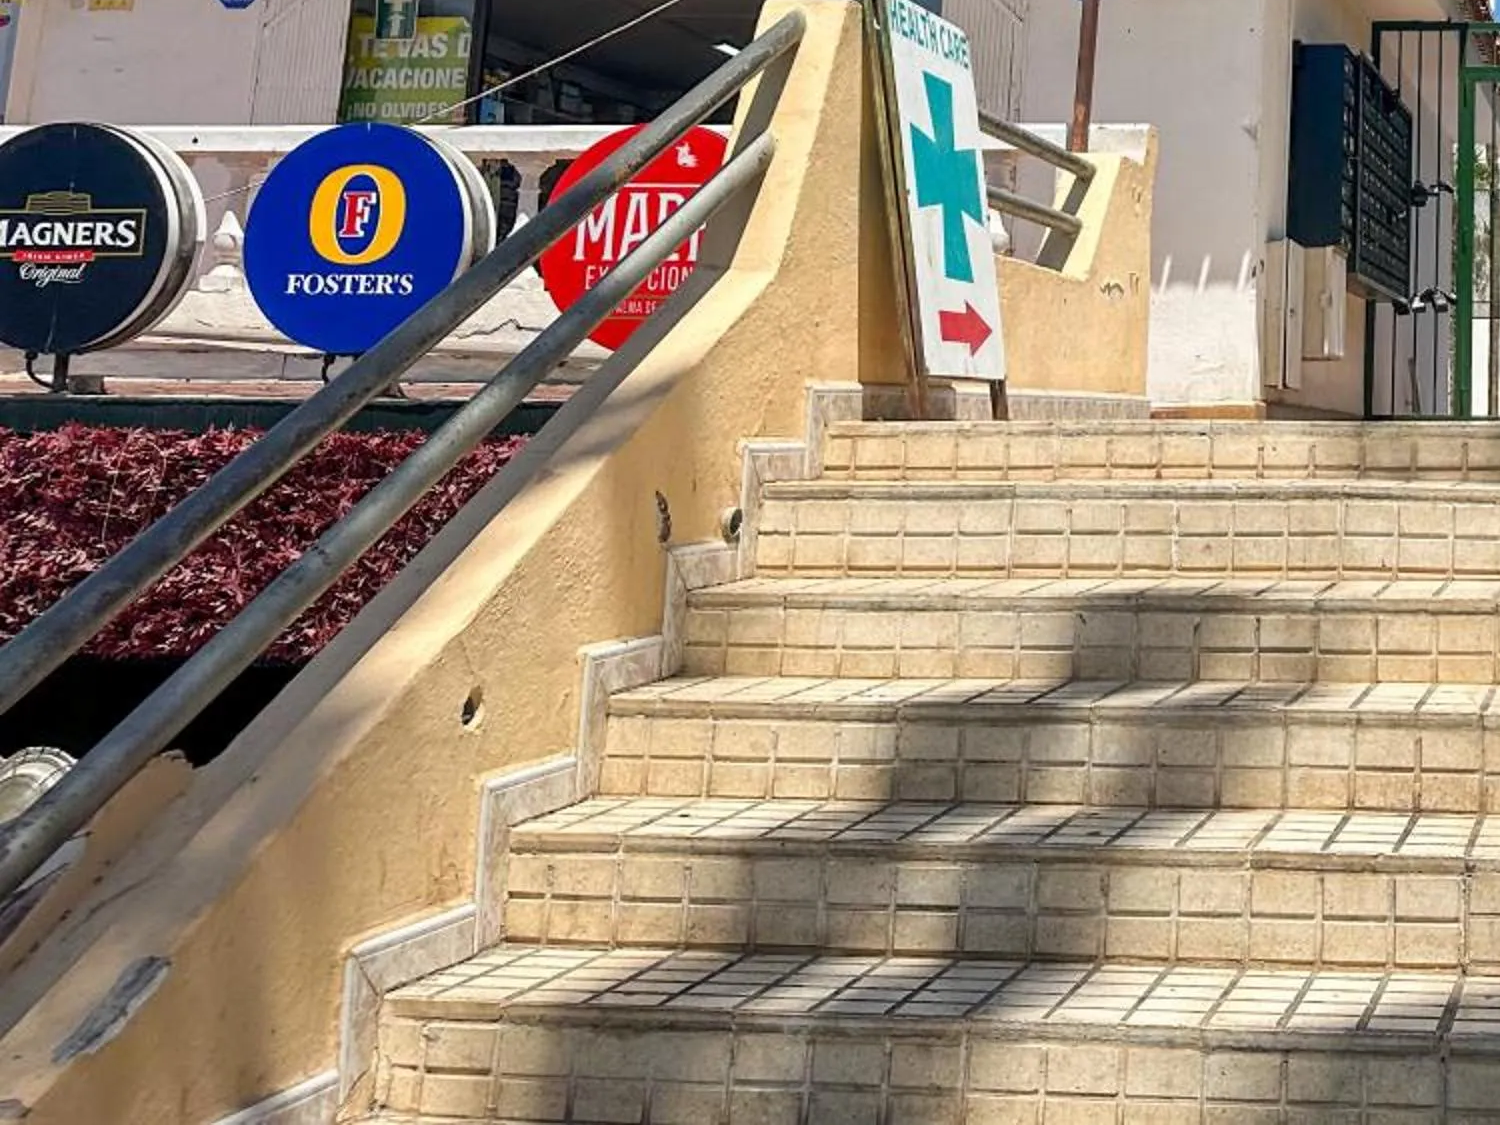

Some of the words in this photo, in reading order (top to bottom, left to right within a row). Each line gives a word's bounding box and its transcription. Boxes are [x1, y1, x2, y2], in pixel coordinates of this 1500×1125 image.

[939, 24, 970, 70] CARE
[345, 67, 466, 90] ACACIONE
[0, 218, 137, 248] AGNERS
[284, 273, 414, 296] FOSTER'S
